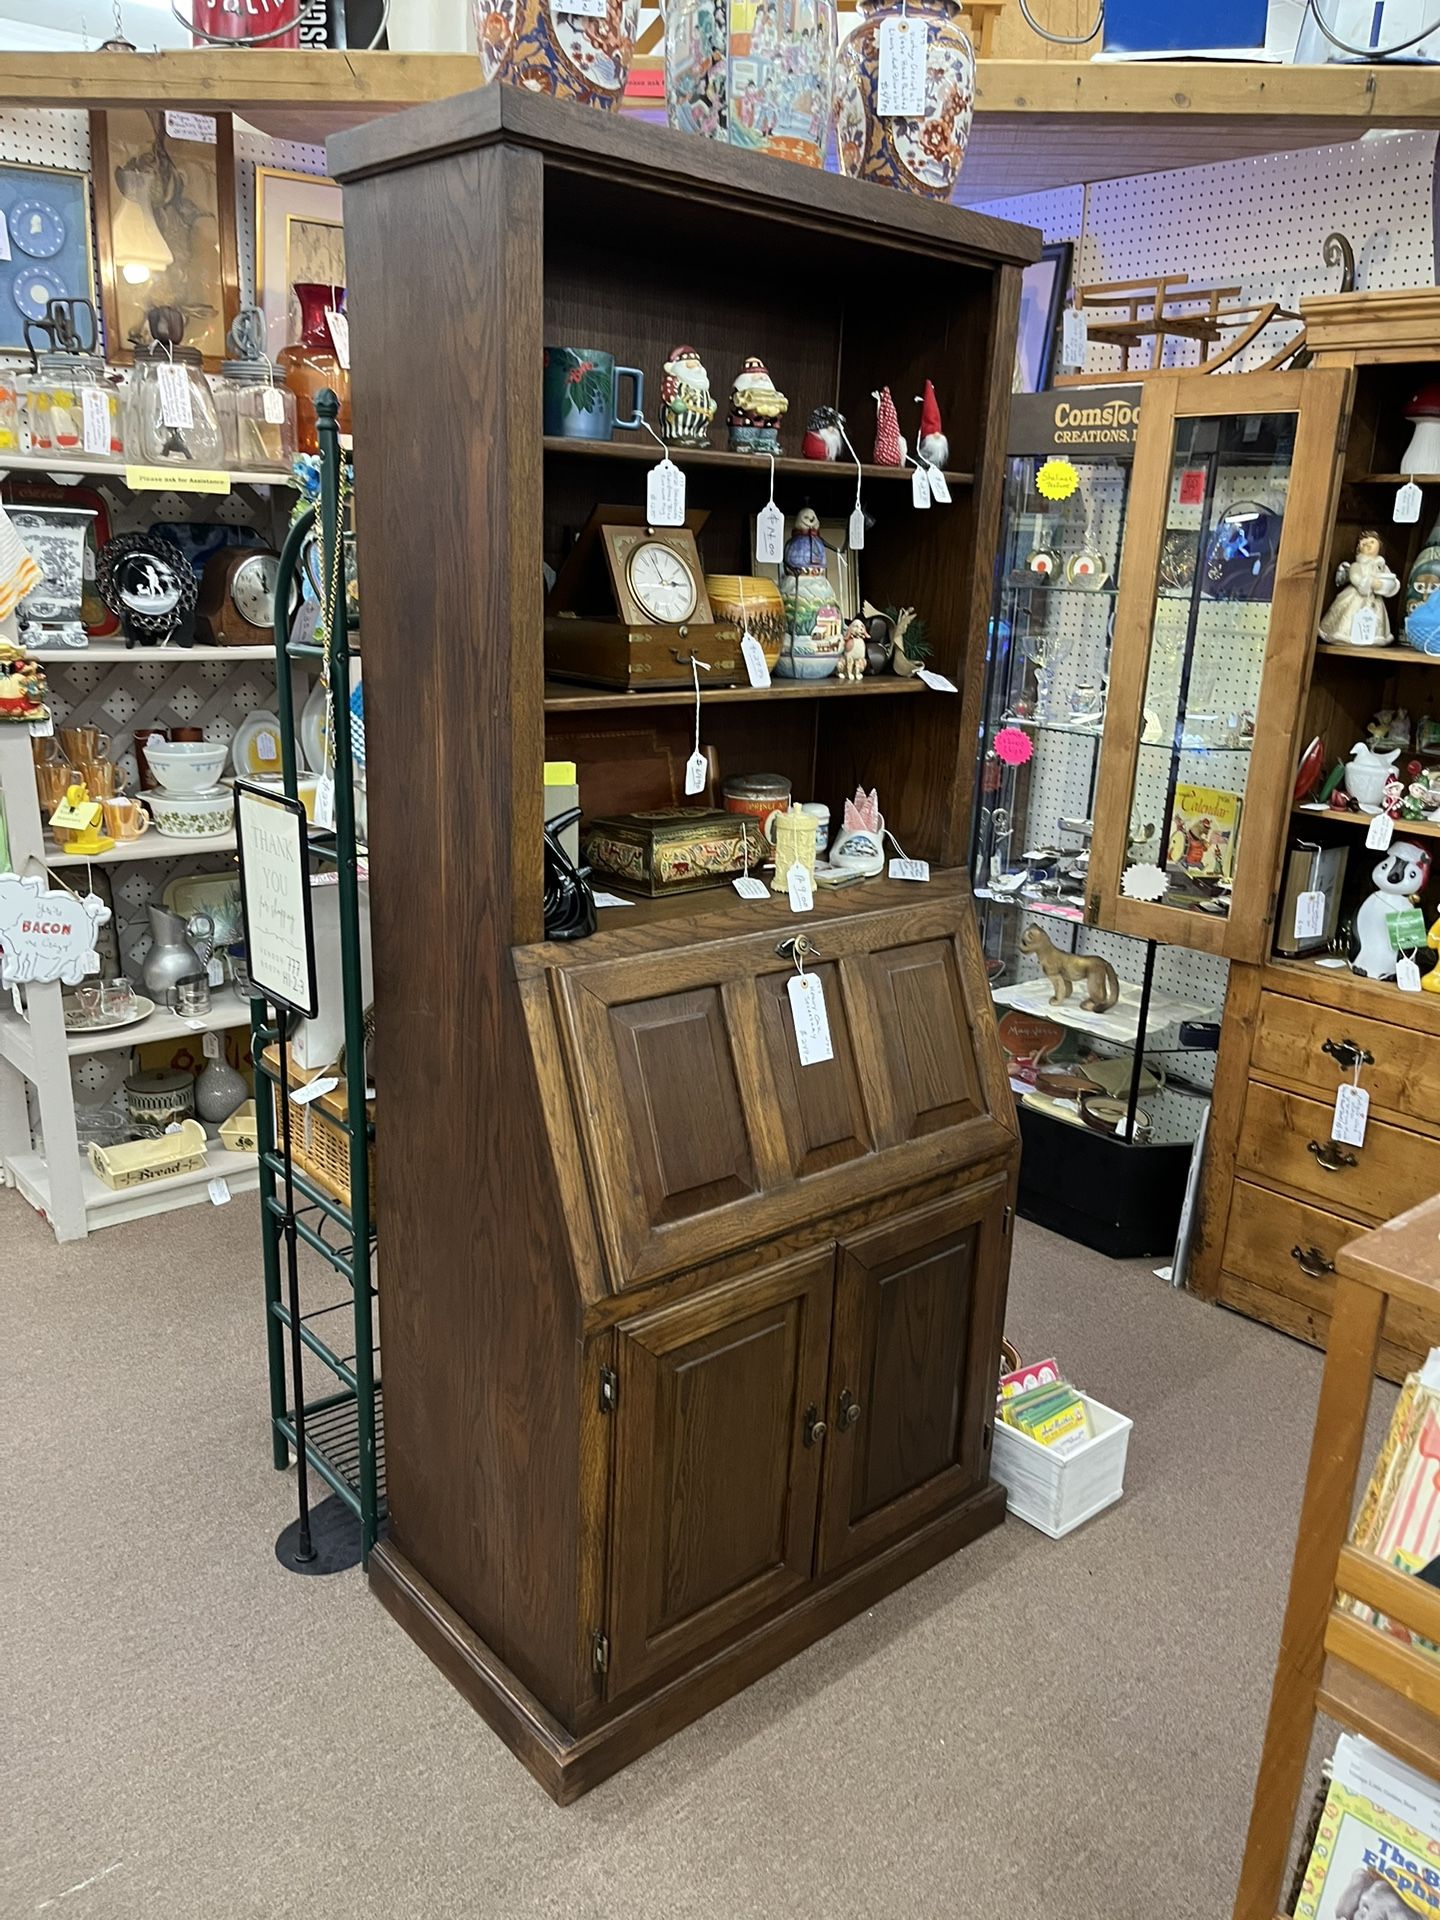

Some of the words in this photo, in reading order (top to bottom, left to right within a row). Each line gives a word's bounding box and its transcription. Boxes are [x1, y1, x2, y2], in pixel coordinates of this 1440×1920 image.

[1054, 429, 1130, 443] CREATIONS,
[250, 826, 294, 863] THANK
[262, 866, 288, 897] YOU
[22, 920, 72, 935] BACON
[270, 898, 295, 935] shopping
[139, 1162, 181, 1181] Bread
[1378, 1837, 1418, 1875] The
